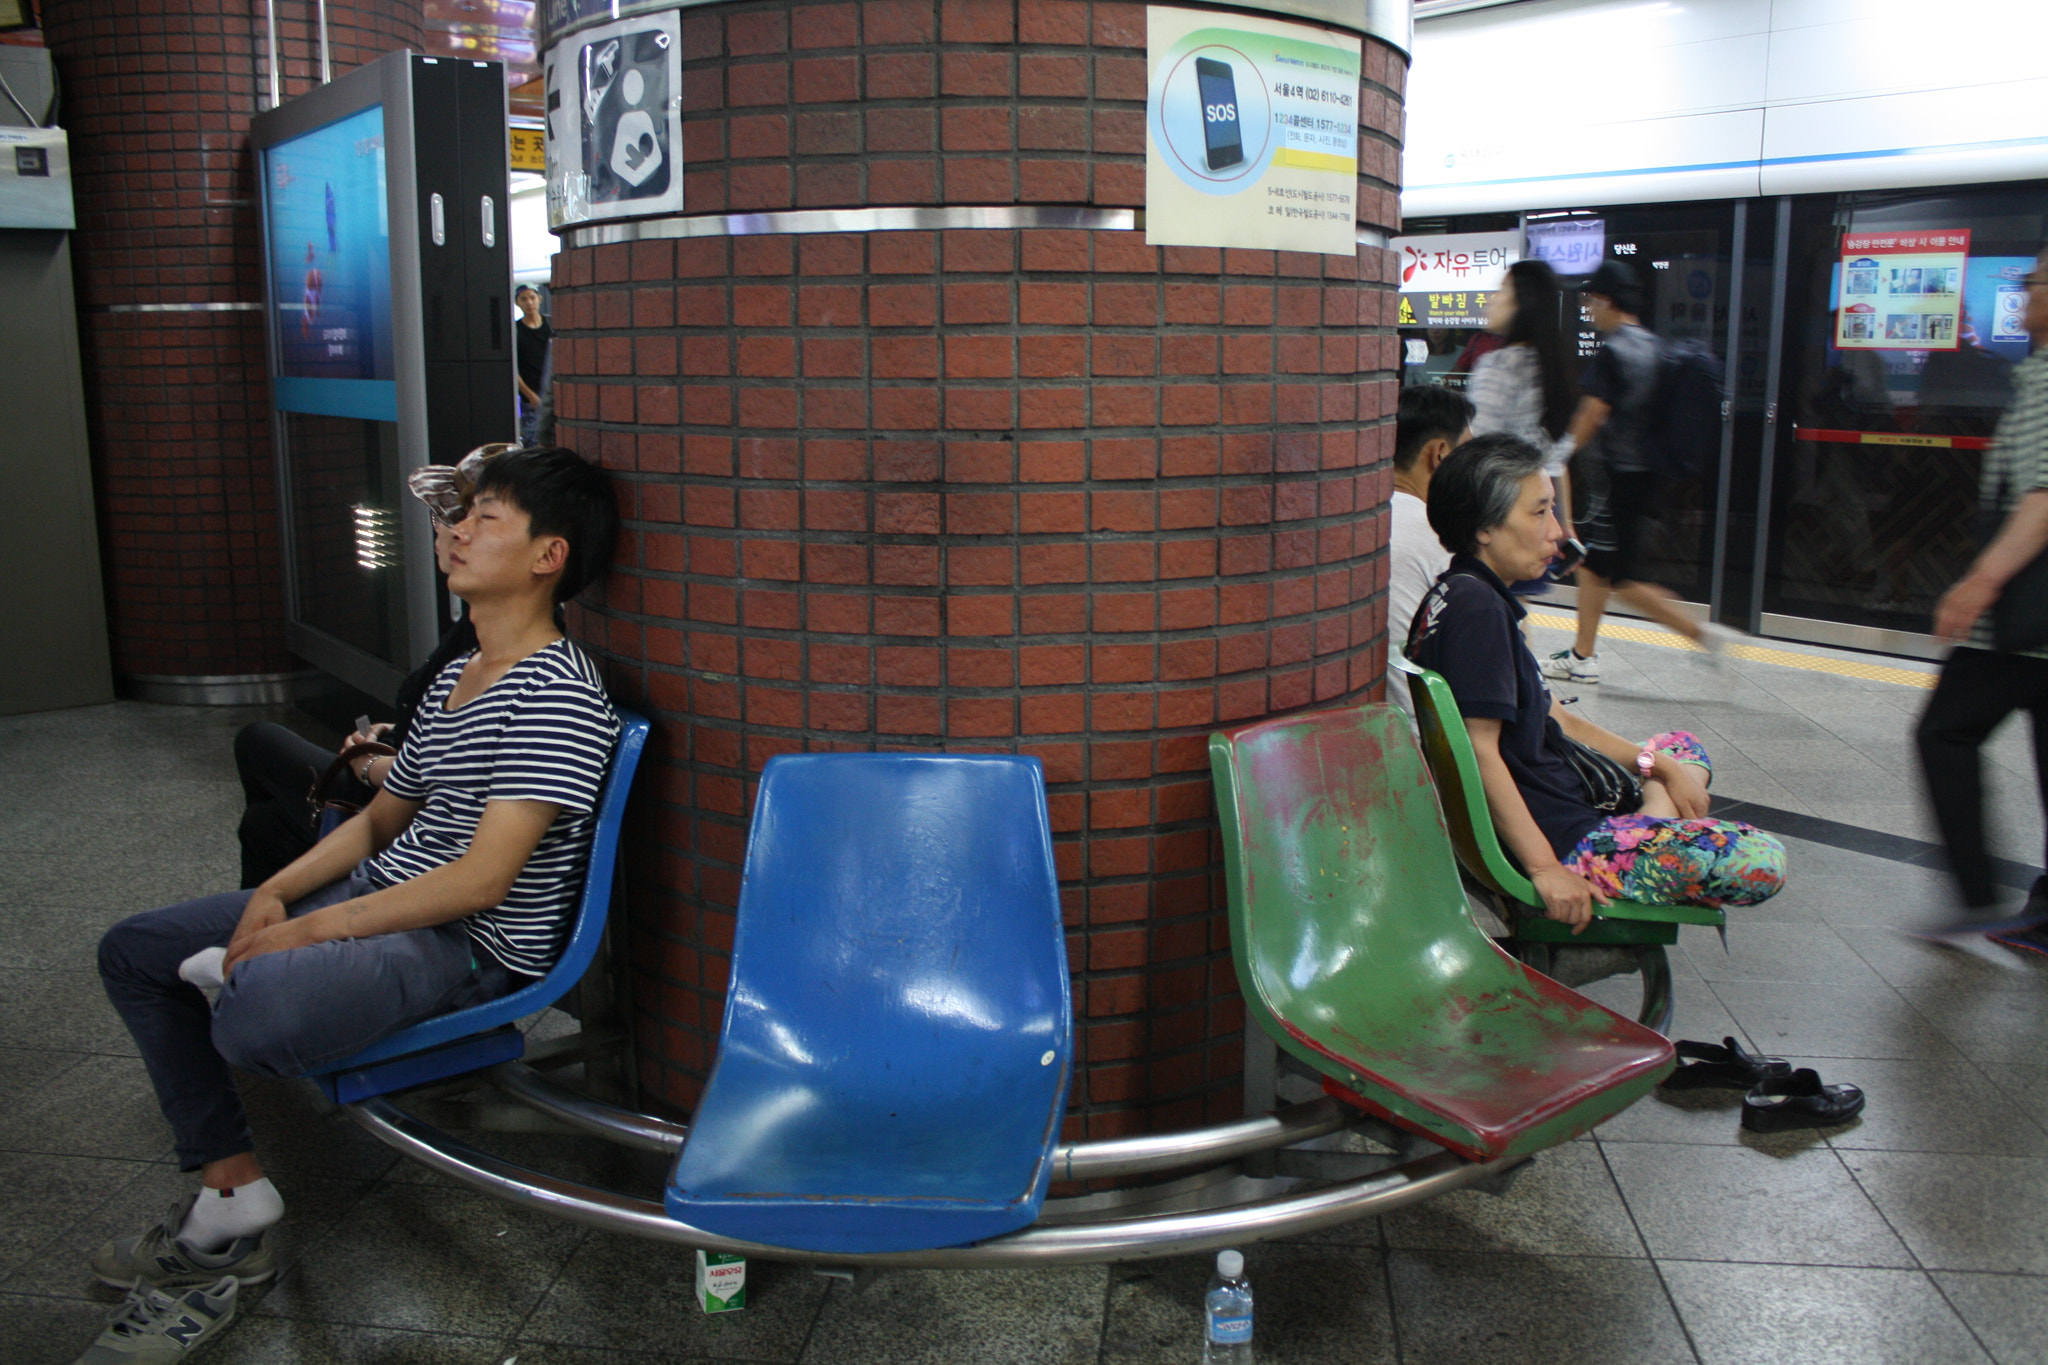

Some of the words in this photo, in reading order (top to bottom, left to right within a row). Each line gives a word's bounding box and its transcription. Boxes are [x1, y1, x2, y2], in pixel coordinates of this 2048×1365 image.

[1274, 83, 1303, 99] 서울4역
[1306, 87, 1320, 102] (02)
[1206, 103, 1236, 122] SOS
[1613, 243, 1637, 255] 당신은
[1433, 247, 1507, 277] 자유투어
[1429, 293, 1467, 309] 발빠짐
